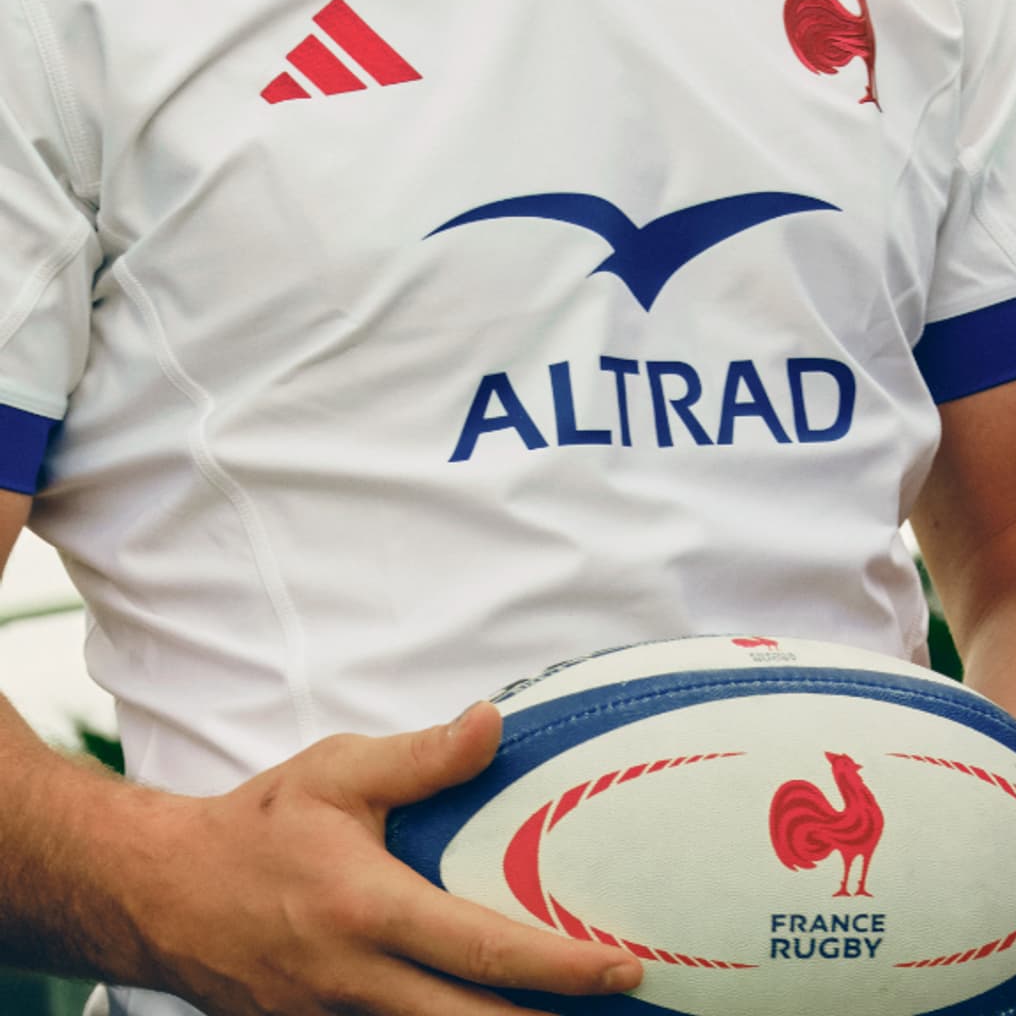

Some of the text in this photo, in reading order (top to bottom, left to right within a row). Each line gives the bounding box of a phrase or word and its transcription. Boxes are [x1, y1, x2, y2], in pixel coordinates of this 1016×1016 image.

[448, 355, 857, 463] ALTRAD
[771, 914, 886, 933] FRANCE
[770, 937, 883, 960] RUGBY
